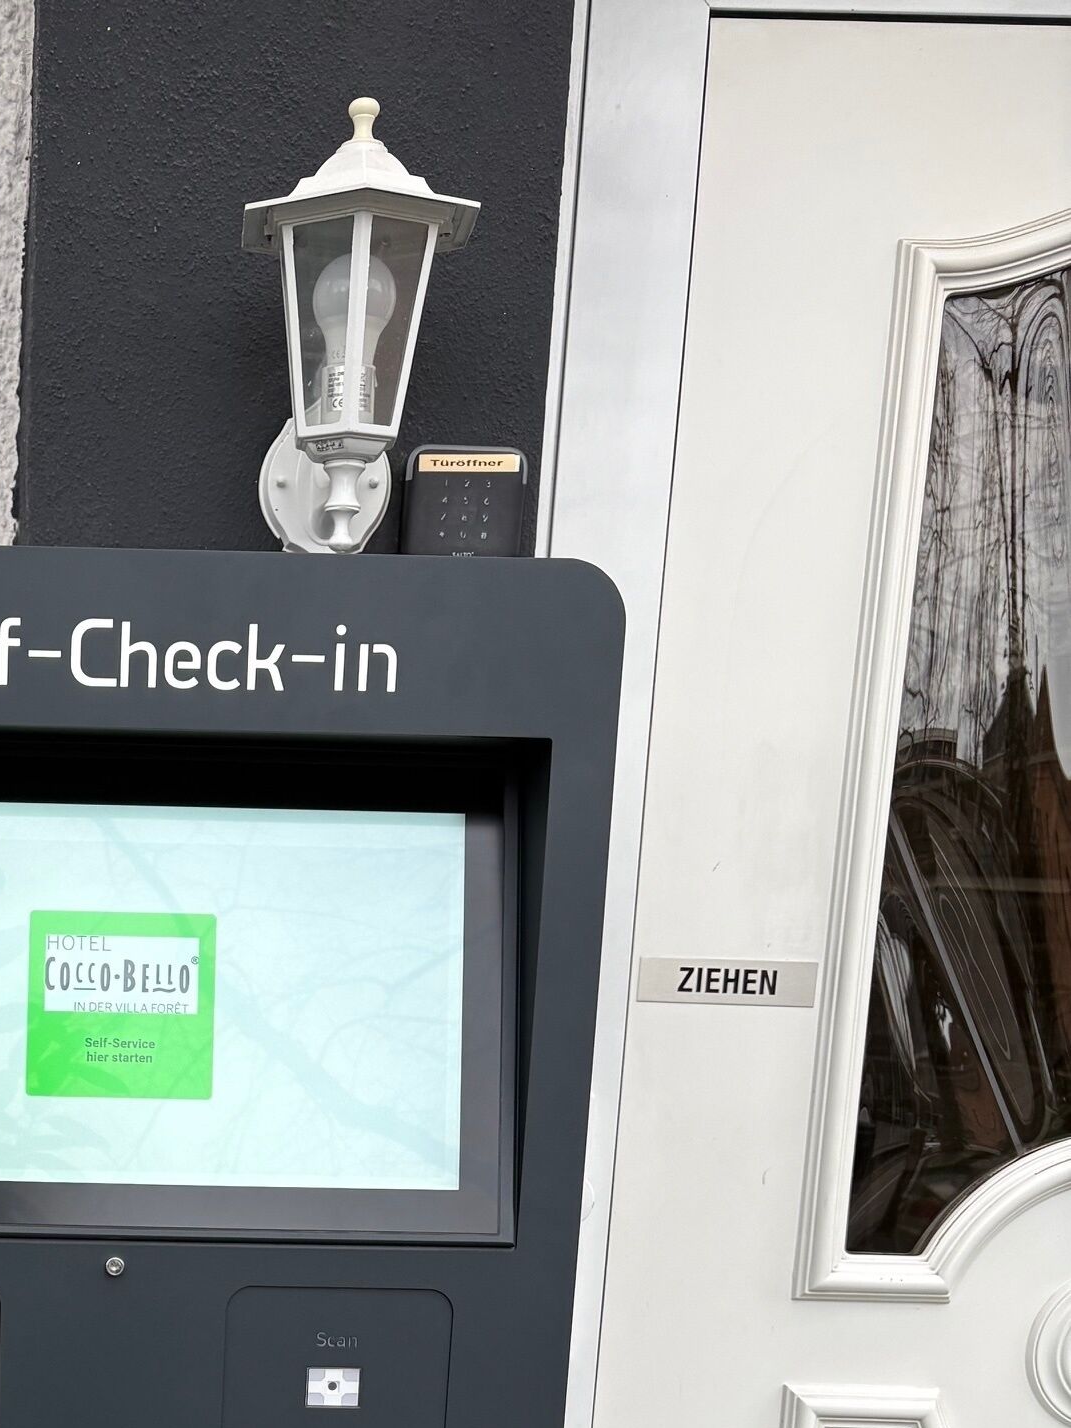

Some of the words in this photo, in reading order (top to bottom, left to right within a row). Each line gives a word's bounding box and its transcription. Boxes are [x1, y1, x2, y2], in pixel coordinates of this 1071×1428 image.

[430, 459, 504, 467] Türöffner
[47, 935, 112, 951] HOTEL
[677, 967, 778, 995] ZIEHEN
[73, 1002, 86, 1012] IN
[89, 1002, 112, 1013] DER
[115, 1003, 148, 1013] VILLA
[151, 1002, 189, 1014] FORÊT
[84, 1037, 156, 1049] Self-Service
[86, 1051, 109, 1062] hier
[112, 1053, 153, 1063] starten
[316, 1332, 358, 1348] Scan
